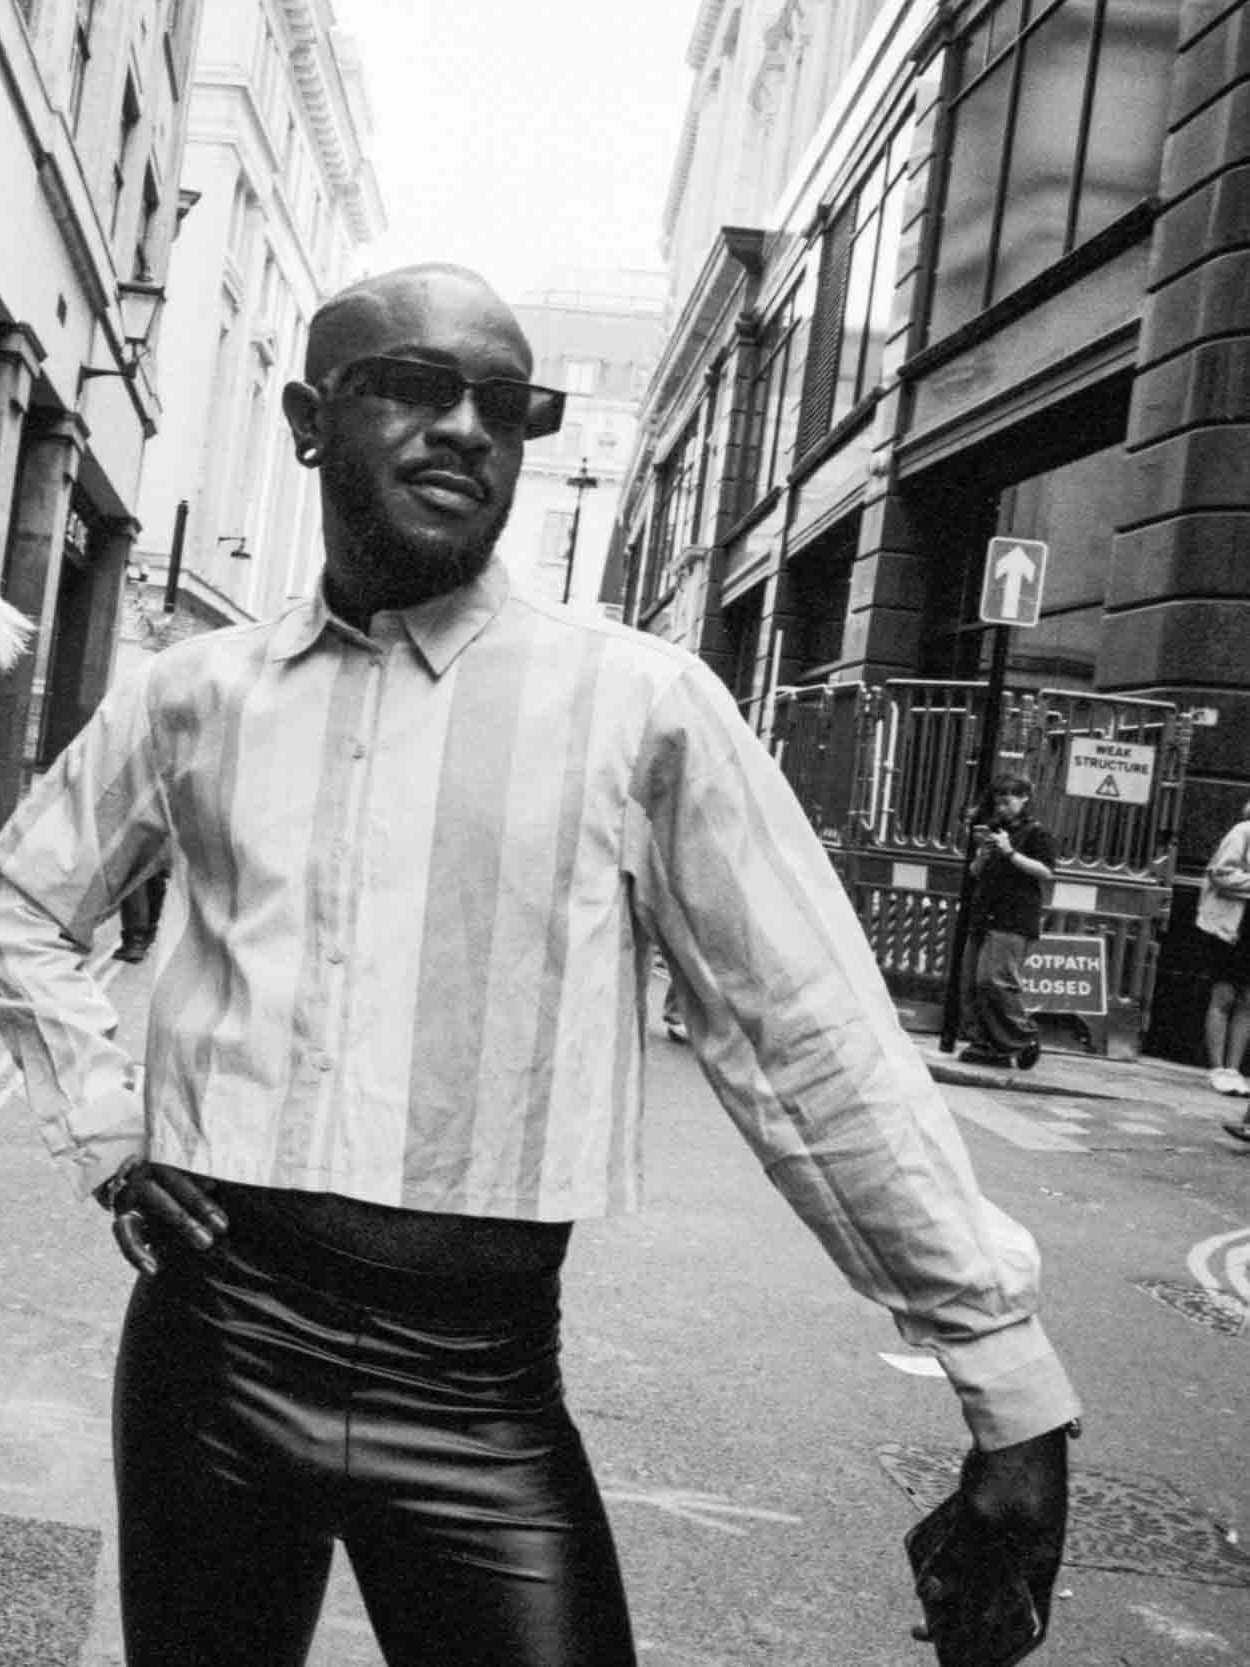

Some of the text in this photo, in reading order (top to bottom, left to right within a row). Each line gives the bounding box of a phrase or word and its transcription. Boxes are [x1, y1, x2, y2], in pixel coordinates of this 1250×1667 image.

[1096, 745, 1132, 758] WEAK
[1074, 755, 1149, 775] STRUCTURE
[1023, 953, 1100, 971] OTPATH
